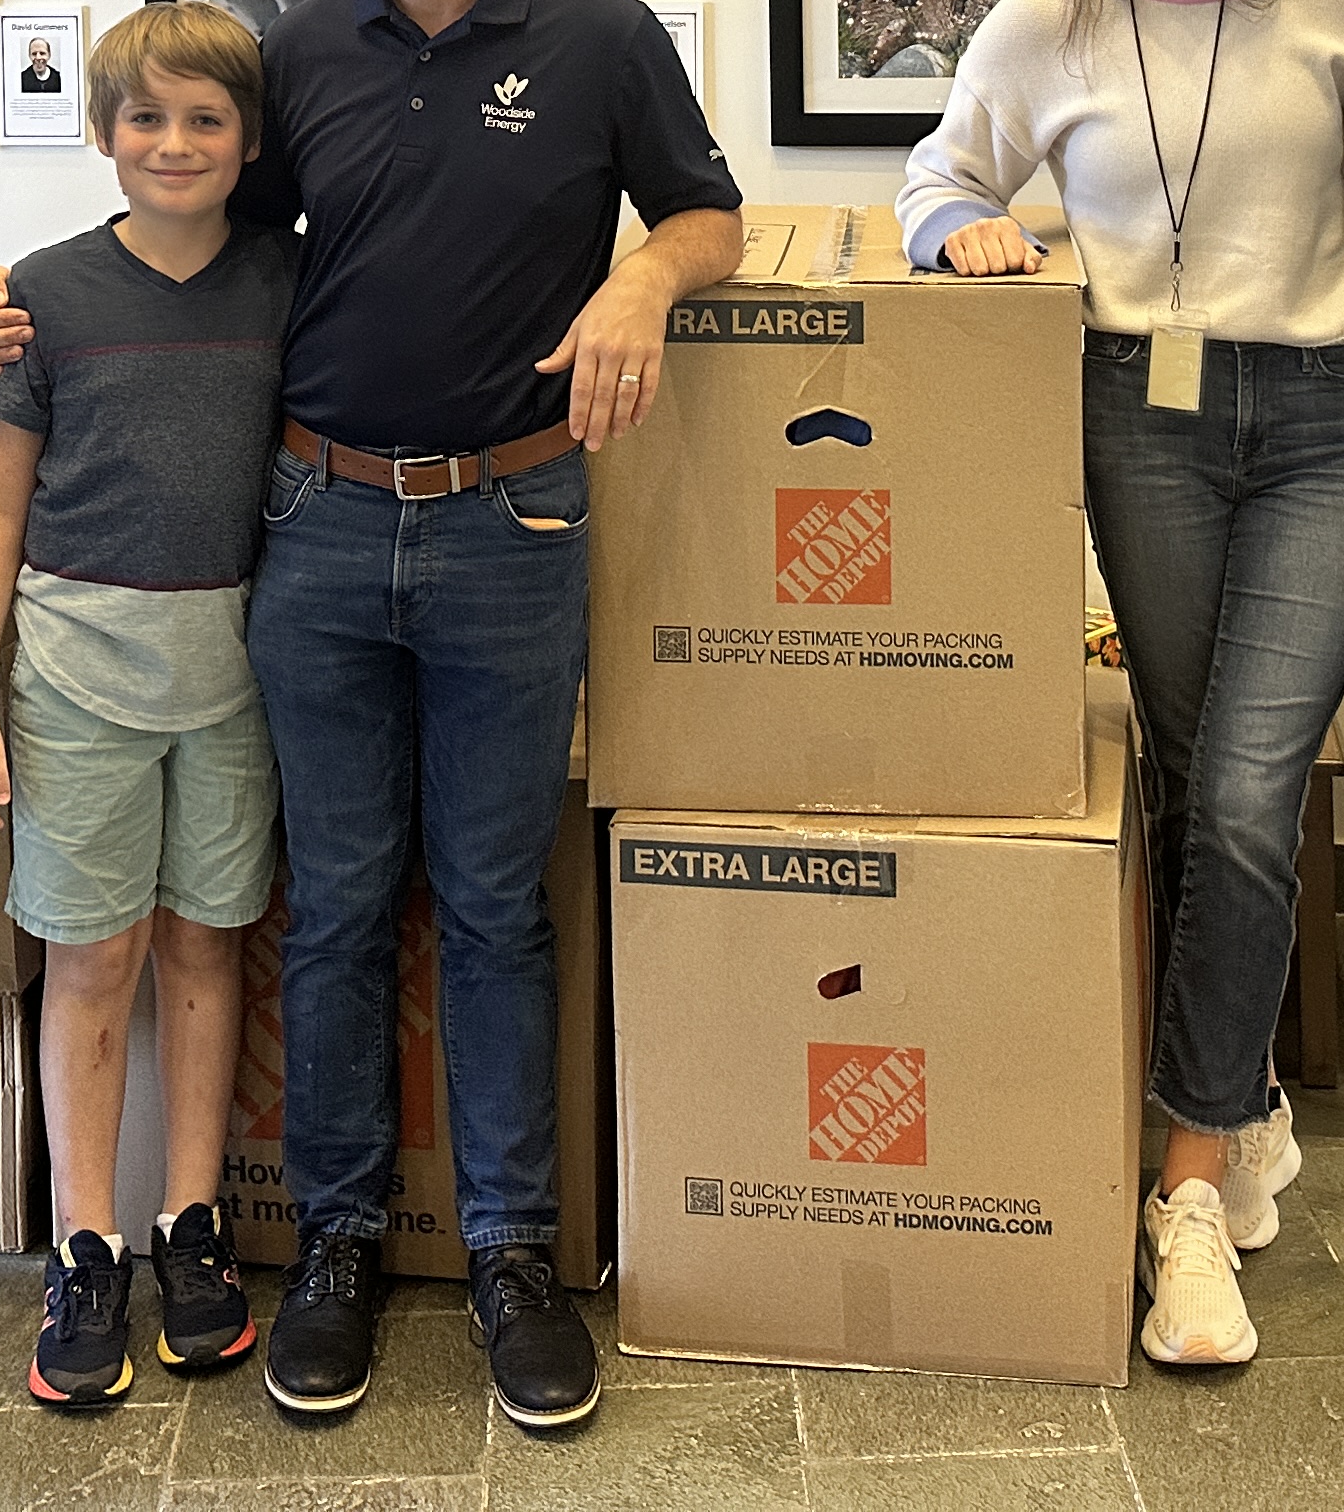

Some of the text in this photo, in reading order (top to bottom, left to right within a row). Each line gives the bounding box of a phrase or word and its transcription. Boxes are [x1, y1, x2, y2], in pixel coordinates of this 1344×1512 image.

[481, 103, 535, 119] Woodside
[484, 116, 526, 133] Energy
[731, 308, 849, 336] LARGE
[786, 500, 834, 546] THE
[776, 489, 891, 603] HOME
[822, 531, 891, 603] DEPOT
[698, 627, 1002, 650] QUICKLY ESTIMATE YOUR PACKING
[698, 647, 1014, 669] SUPPLY NEEDS AT HDMOVING.COM
[634, 847, 881, 887] EXTRA LARGE
[819, 1056, 868, 1103] THE
[809, 1047, 925, 1162] HOME
[856, 1090, 925, 1162] DEPOT
[729, 1180, 1041, 1215] QUICKLY ESTIMATE YOUR PACKING
[729, 1201, 1053, 1236] SUPPLY NEEDS AT HDMOVING.COM
